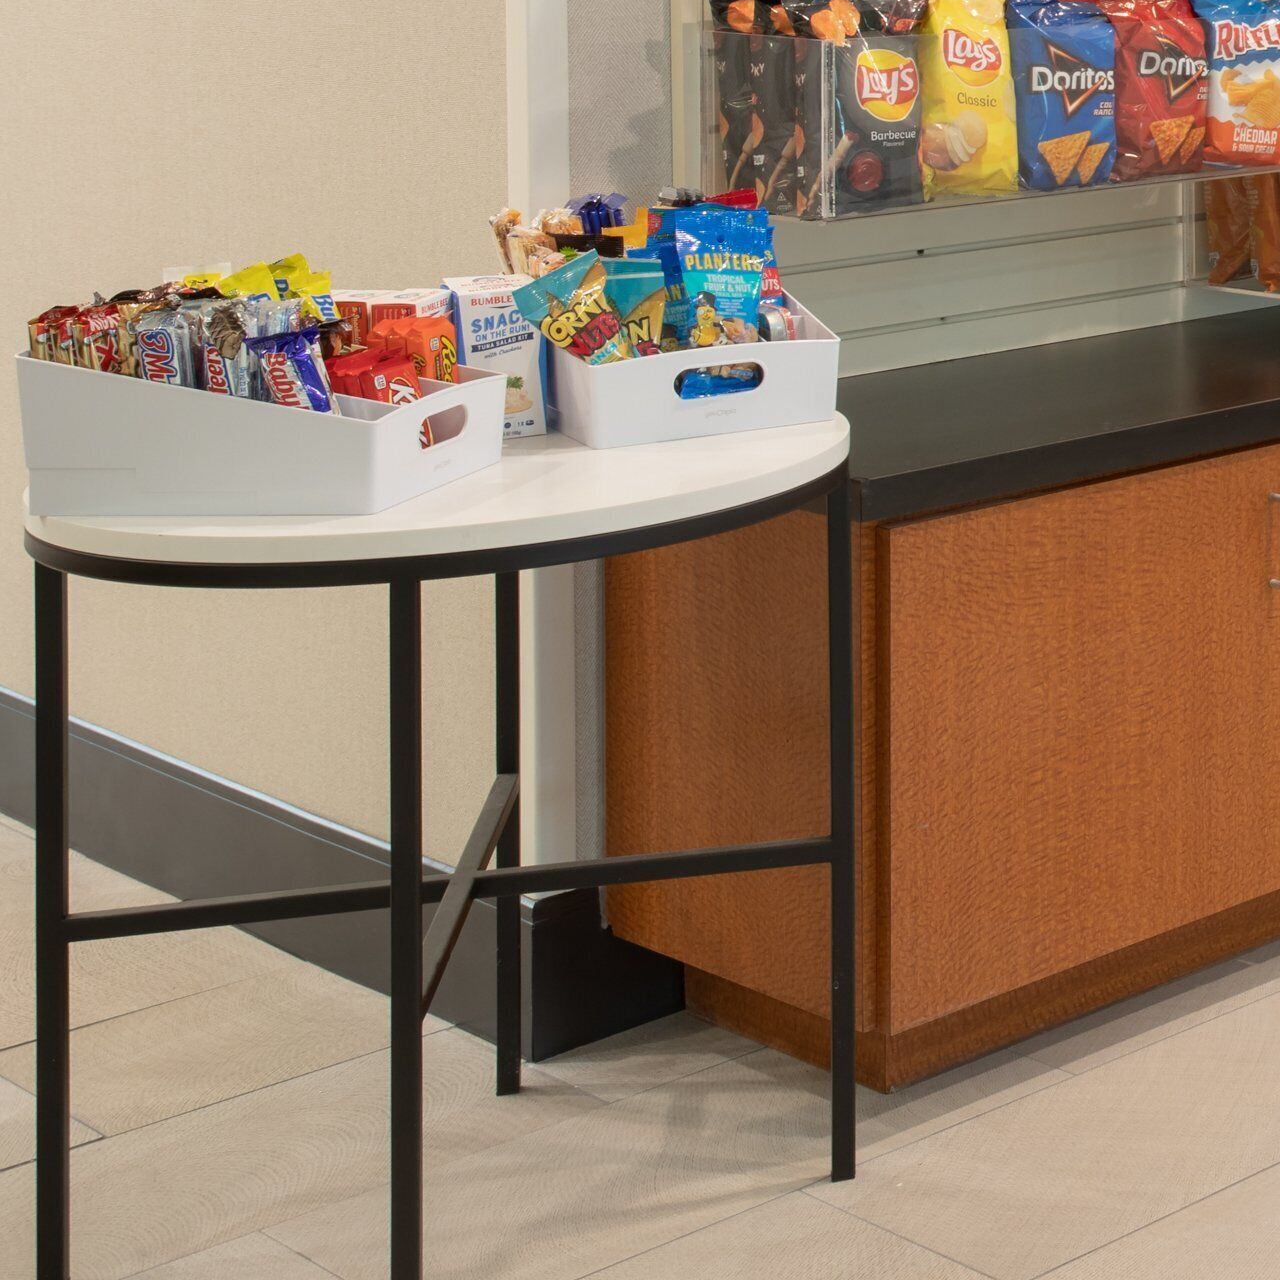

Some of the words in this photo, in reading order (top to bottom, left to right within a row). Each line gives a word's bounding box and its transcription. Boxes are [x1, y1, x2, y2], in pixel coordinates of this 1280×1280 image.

[946, 29, 996, 70] Lay's
[1140, 51, 1208, 77] Doritos
[860, 64, 914, 105] Lay's
[1032, 67, 1114, 92] Doritos
[957, 92, 998, 108] Classic
[870, 130, 916, 141] Barbecue
[1233, 126, 1278, 144] CHEDDAR
[686, 252, 764, 272] PLANTERS
[704, 282, 726, 292] FRUIT
[735, 284, 751, 293] NUT
[706, 274, 744, 284] TROPICAL
[421, 300, 438, 314] BUMBLE
[471, 295, 513, 306] BUMBLE
[540, 294, 605, 349] CORN
[475, 334, 488, 342] ON
[490, 329, 507, 340] THE
[509, 324, 530, 338] RUN!
[478, 341, 496, 350] TUNA
[496, 337, 514, 348] SALAD
[516, 334, 529, 344] KIT
[267, 352, 303, 407] Baby
